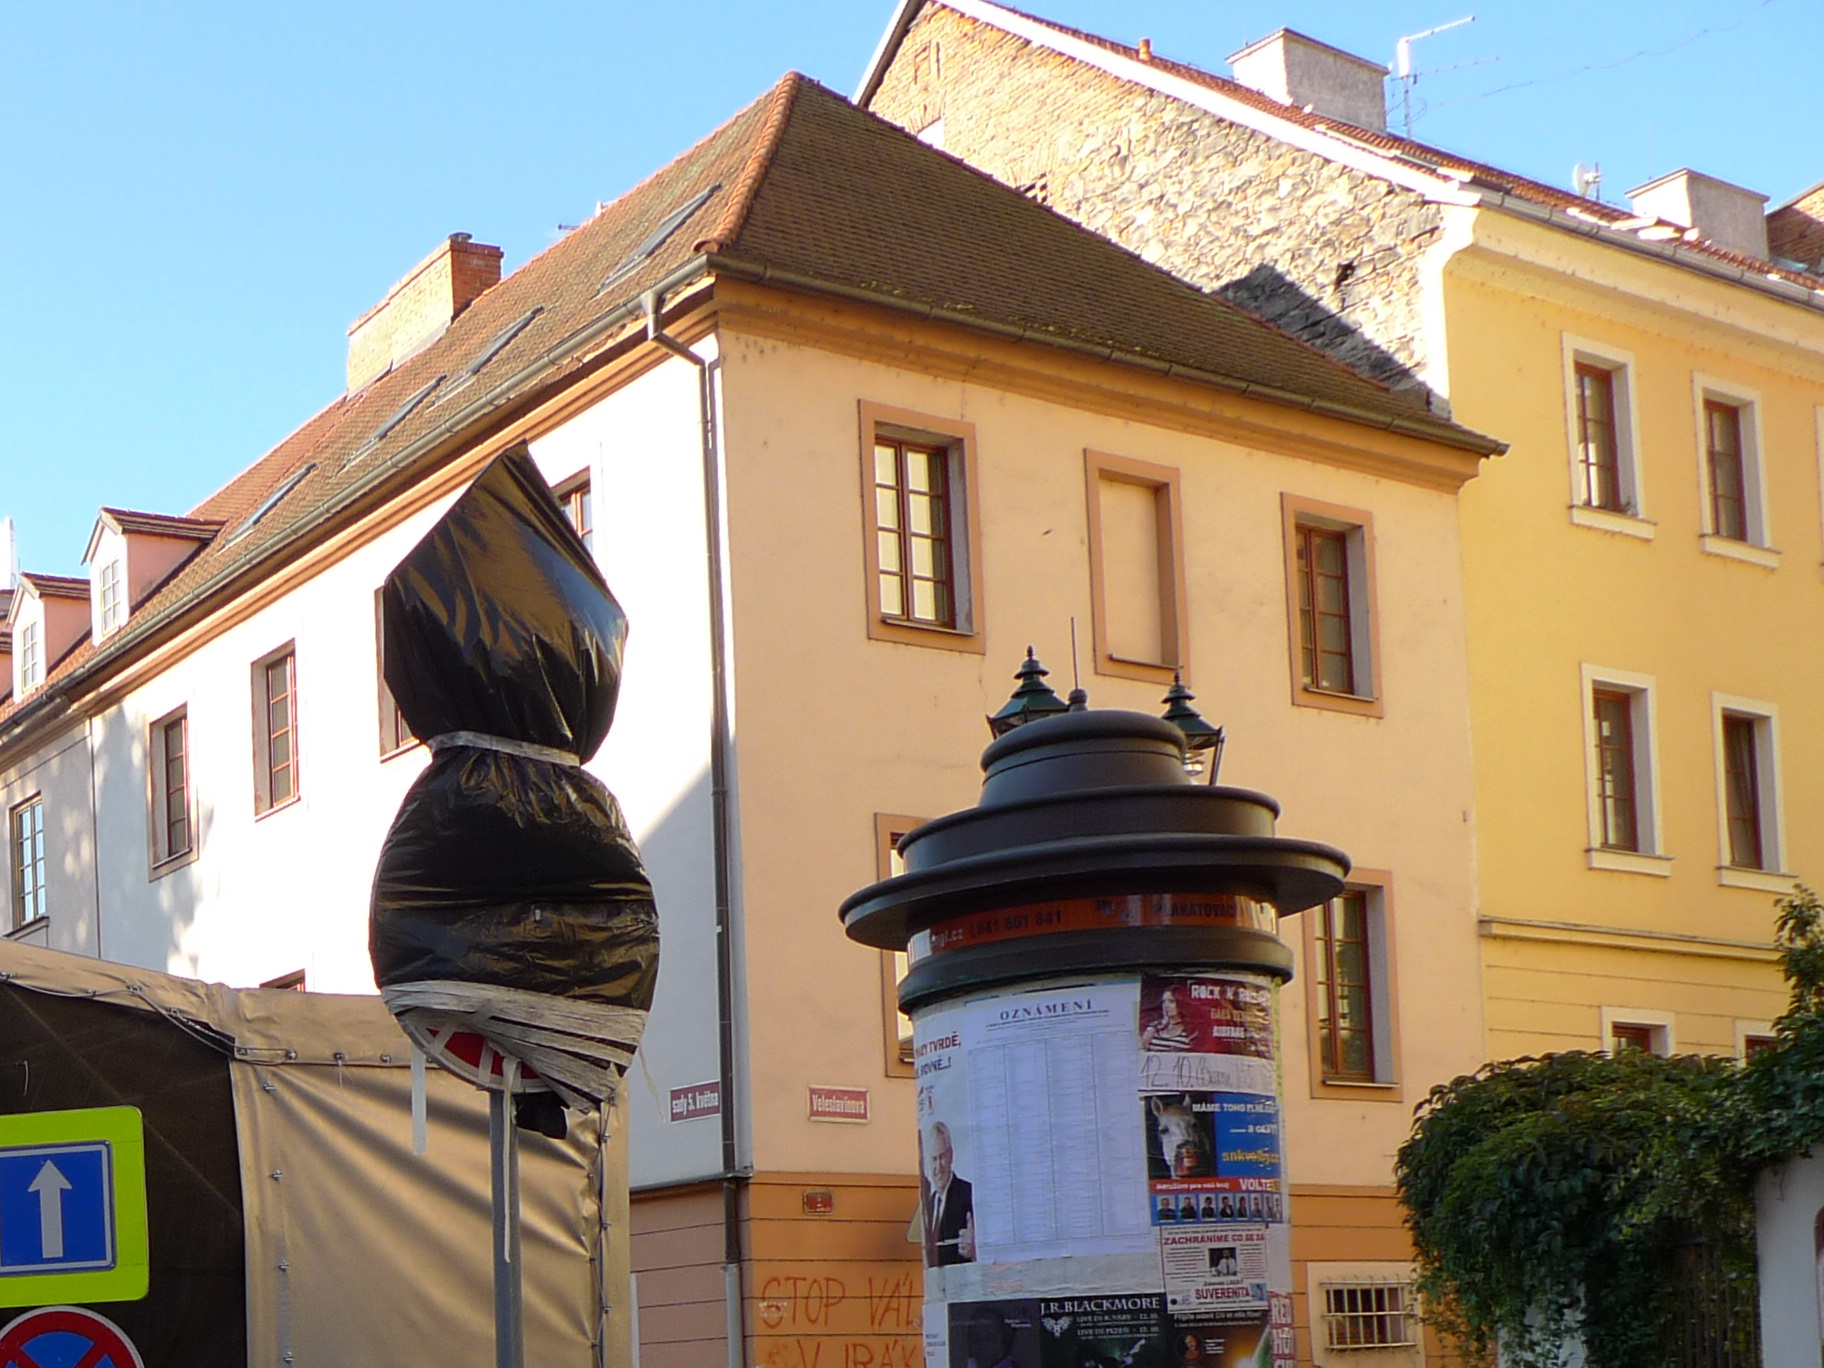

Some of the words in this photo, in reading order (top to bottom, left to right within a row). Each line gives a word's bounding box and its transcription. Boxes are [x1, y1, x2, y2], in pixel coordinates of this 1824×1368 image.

[999, 998, 1093, 1021] OZNÁMENÍ
[695, 1090, 719, 1110] května
[811, 1093, 866, 1115] Veleslavínova
[761, 1276, 846, 1330] STOP
